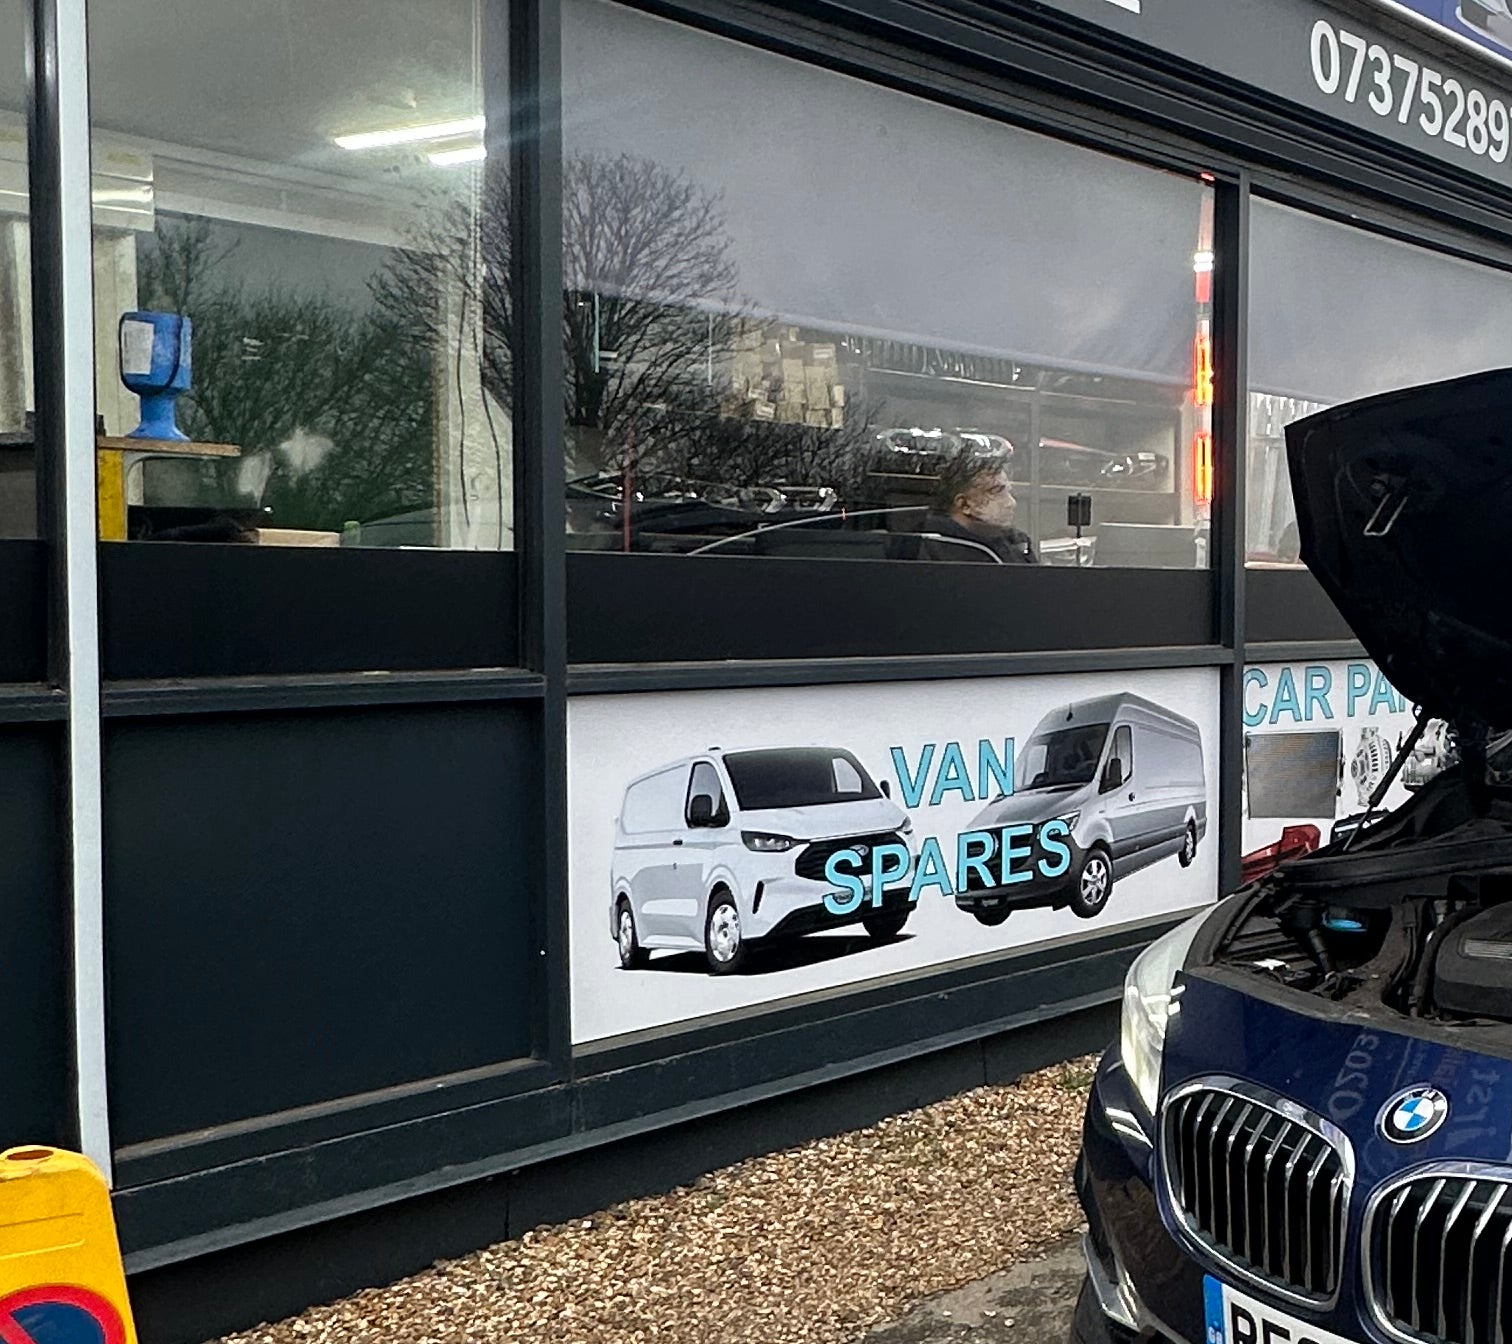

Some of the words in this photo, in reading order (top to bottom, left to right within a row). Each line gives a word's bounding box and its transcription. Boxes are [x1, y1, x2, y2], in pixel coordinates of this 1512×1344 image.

[1243, 666, 1334, 726] CAR
[1347, 663, 1405, 717] PA
[890, 737, 1016, 809] VAN
[822, 819, 1071, 915] SPARES
